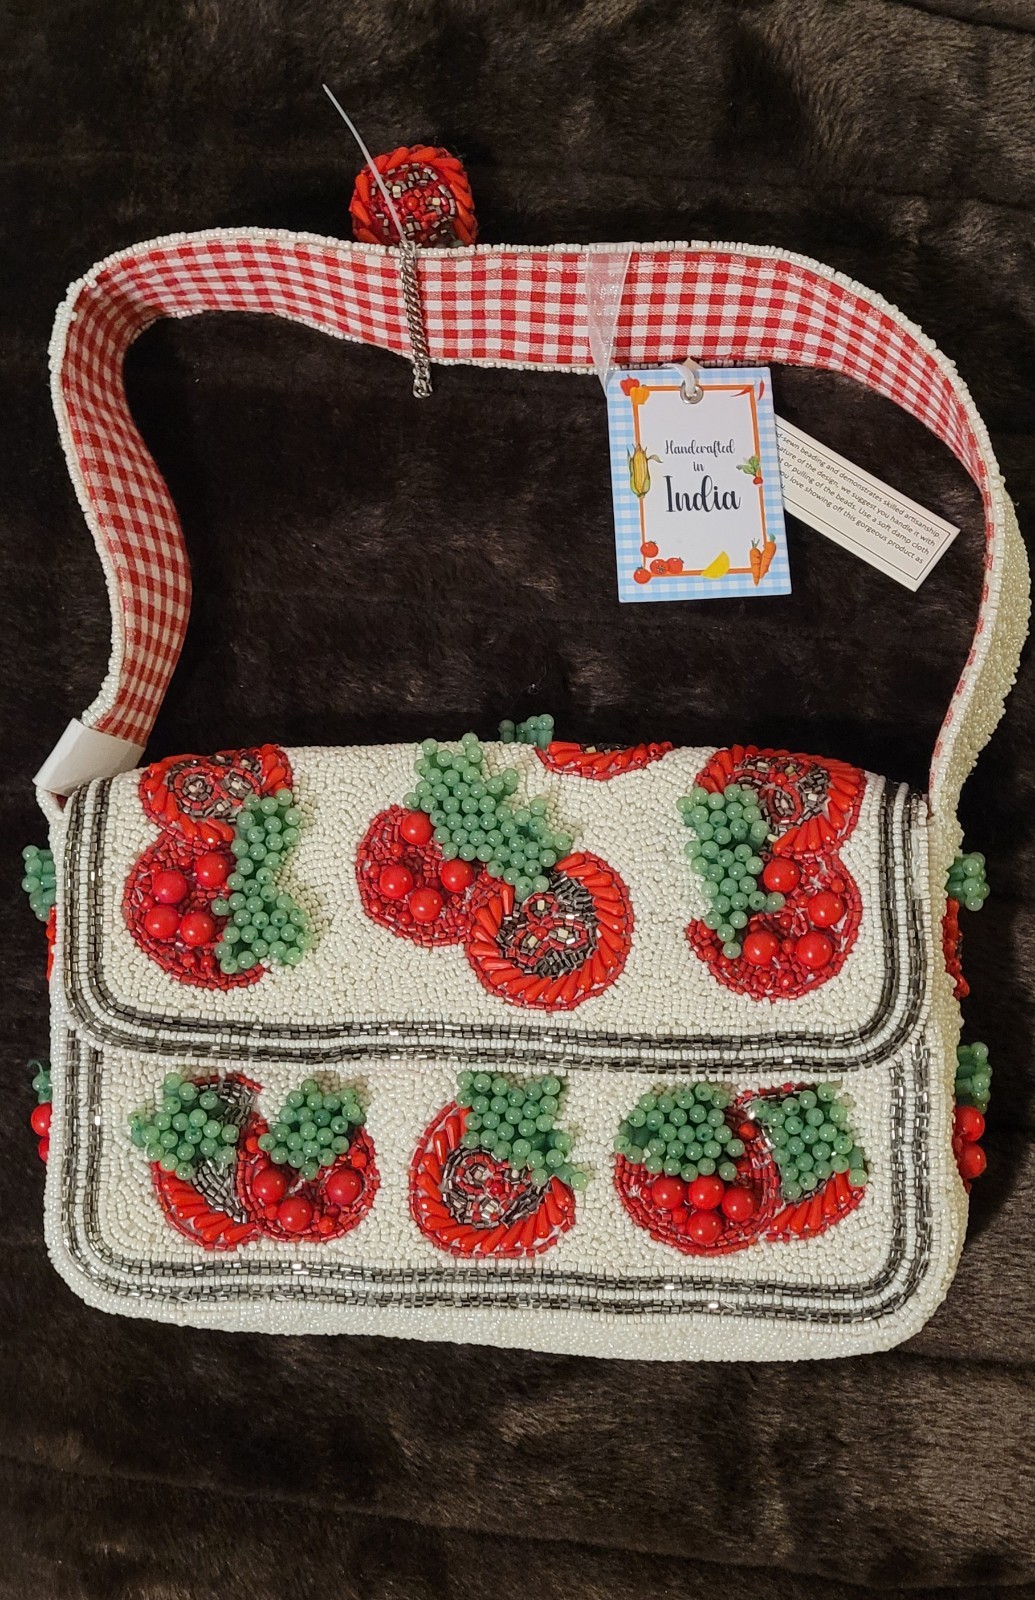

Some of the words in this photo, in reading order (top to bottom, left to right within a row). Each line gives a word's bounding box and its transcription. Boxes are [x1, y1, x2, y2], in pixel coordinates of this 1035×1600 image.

[664, 438, 736, 458] Handcrafted
[692, 461, 705, 472] in
[662, 474, 742, 513] India
[789, 475, 804, 489] love
[803, 486, 833, 508] showing
[832, 504, 845, 513] off
[842, 510, 856, 522] this
[855, 519, 888, 541] gorgeous
[886, 539, 915, 559] product
[914, 556, 924, 564] as
[791, 466, 815, 484] pulling
[823, 485, 835, 496] the
[834, 492, 857, 511] beads.
[858, 507, 872, 519] Use
[876, 520, 891, 532] soft
[891, 529, 912, 544] damp
[911, 542, 929, 555] cloth
[799, 446, 826, 468] beading
[825, 464, 840, 475] and
[838, 472, 883, 502] demonstrates
[882, 500, 905, 515] skilled
[903, 513, 941, 540] artisanship.
[804, 462, 817, 472] the
[816, 470, 839, 488] design,
[840, 485, 851, 495] we
[851, 492, 877, 511] suggest
[876, 508, 890, 519] you
[889, 515, 913, 533] handle
[919, 534, 935, 547] with
